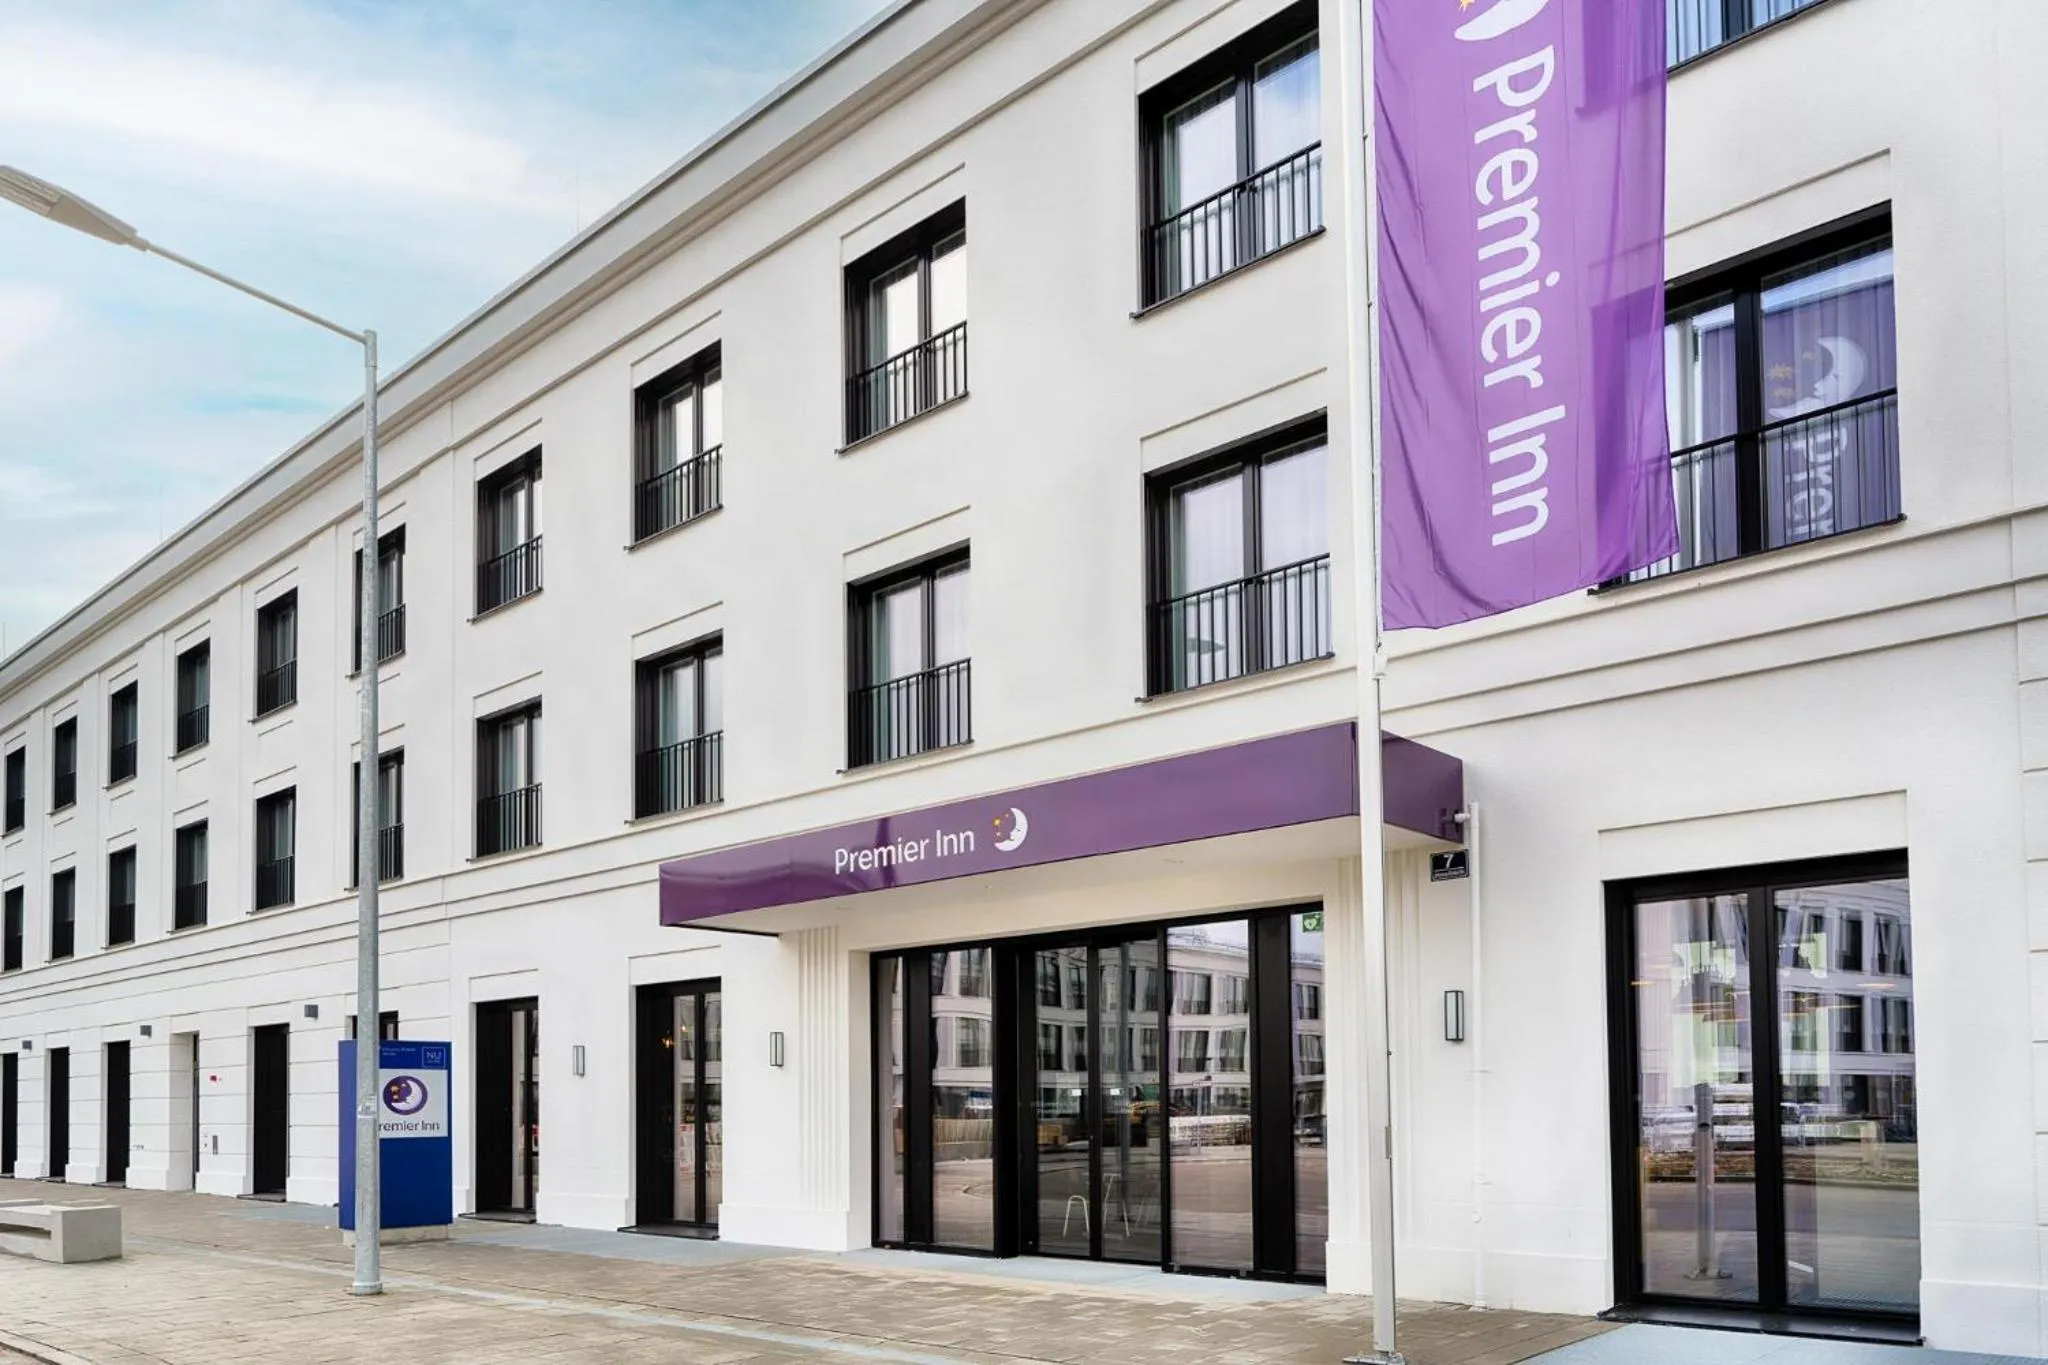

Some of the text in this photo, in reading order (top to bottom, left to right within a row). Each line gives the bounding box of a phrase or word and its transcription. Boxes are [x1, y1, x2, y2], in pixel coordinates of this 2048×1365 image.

[1473, 45, 1566, 546] Premier Inn
[835, 829, 975, 875] Premier Inn
[1443, 853, 1454, 869] 7
[426, 1051, 442, 1060] NU
[379, 1120, 440, 1131] remier Inn
